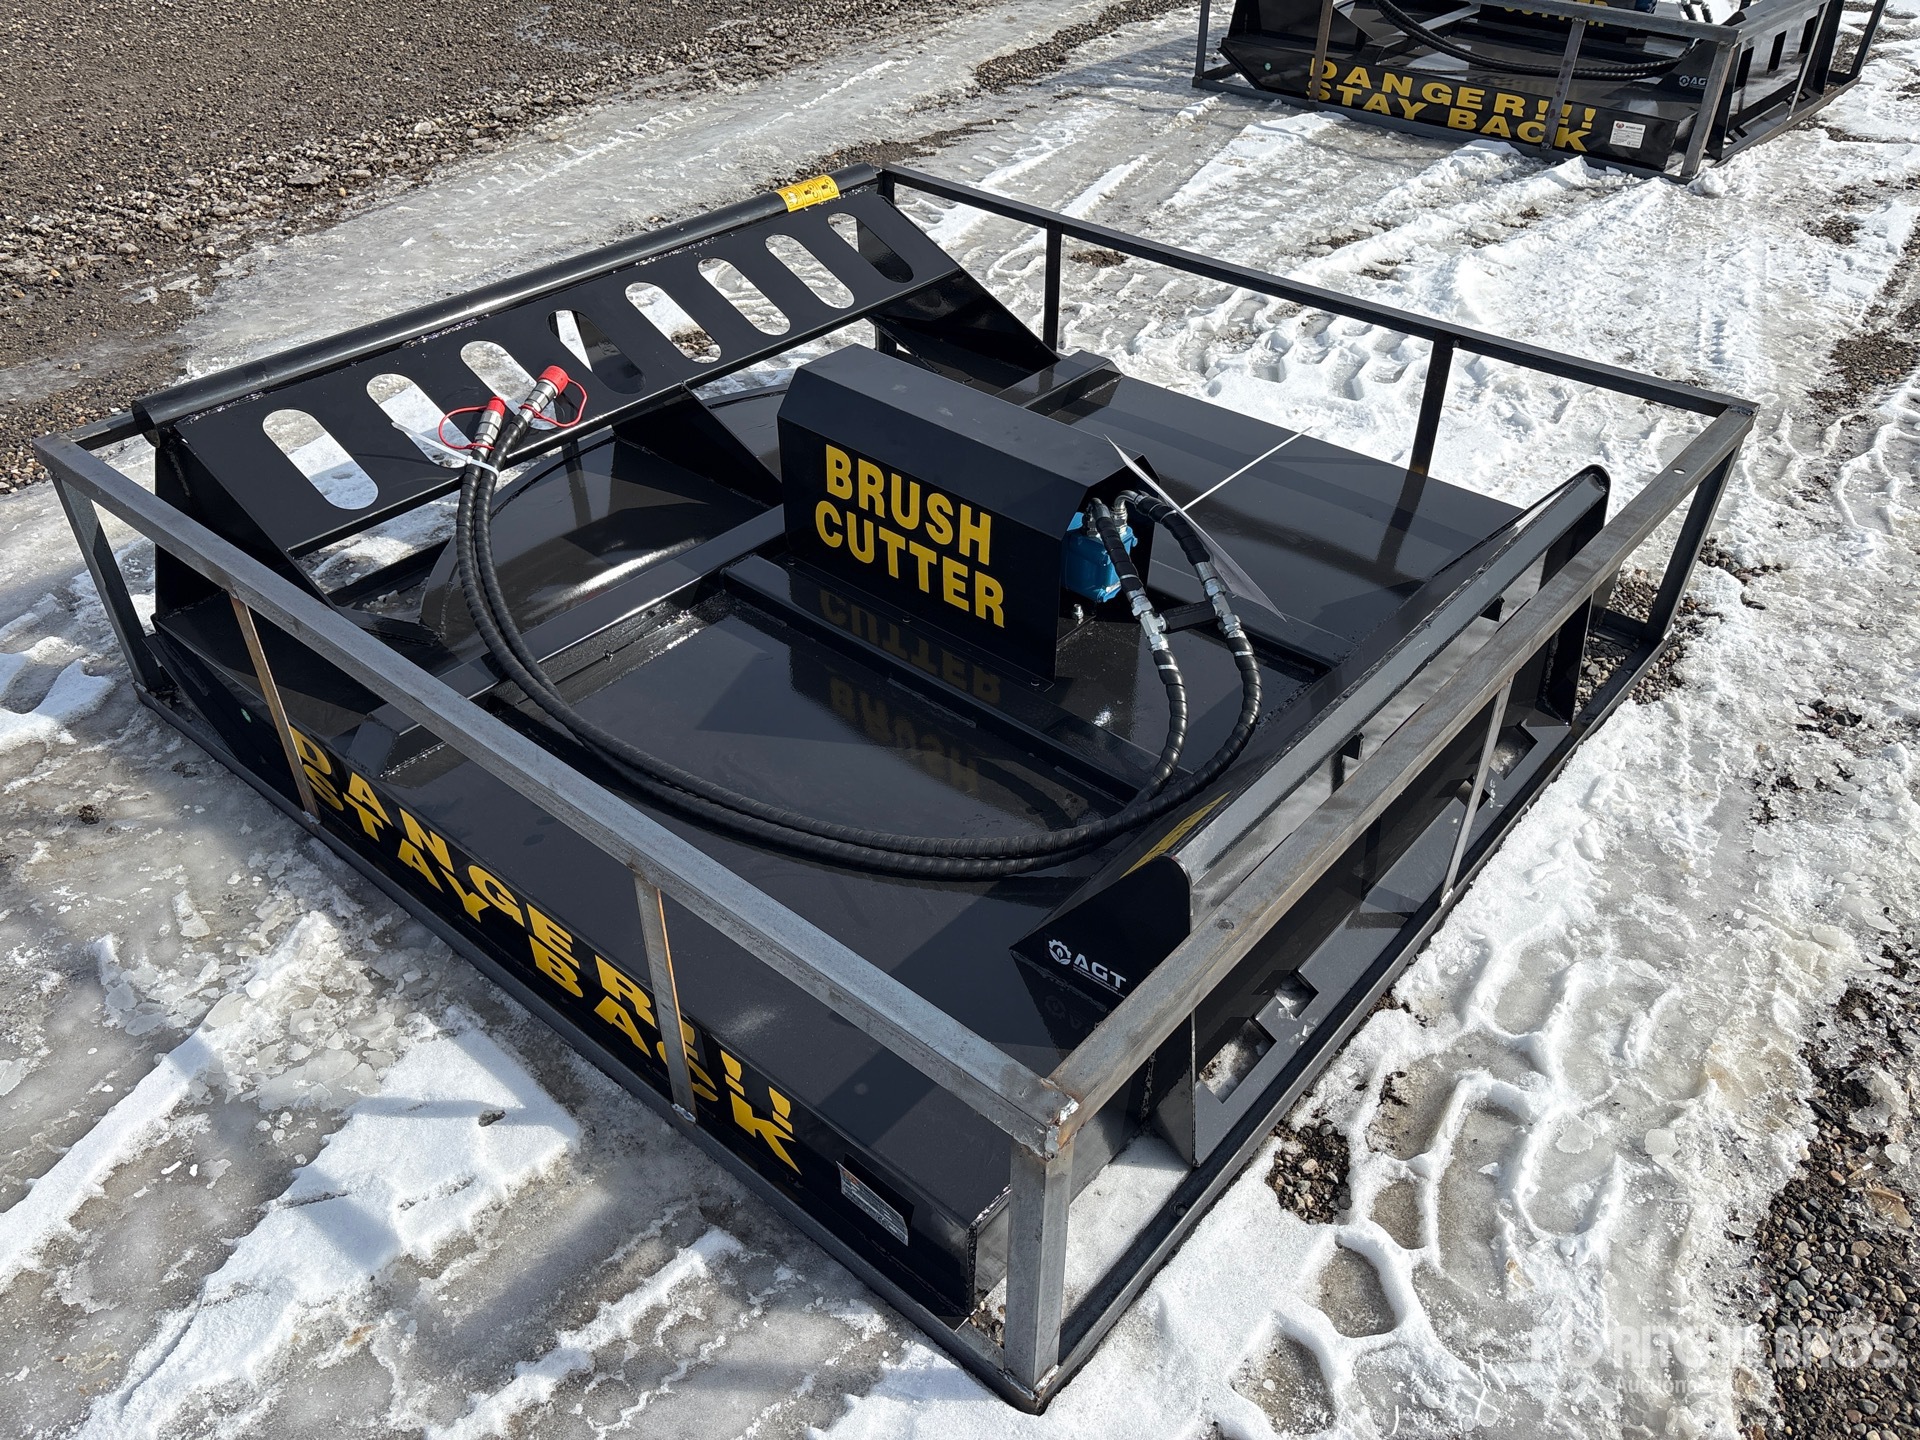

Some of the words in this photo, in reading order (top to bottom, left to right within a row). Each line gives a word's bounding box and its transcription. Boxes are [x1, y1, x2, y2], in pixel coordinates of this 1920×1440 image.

[1306, 80, 1428, 120] STAY
[1447, 107, 1591, 152] BACK
[1690, 76, 1708, 86] AG
[826, 443, 992, 566] BRUSH
[815, 500, 1005, 628] CUTTER
[303, 763, 491, 923] STAY
[1073, 953, 1127, 989] AGT
